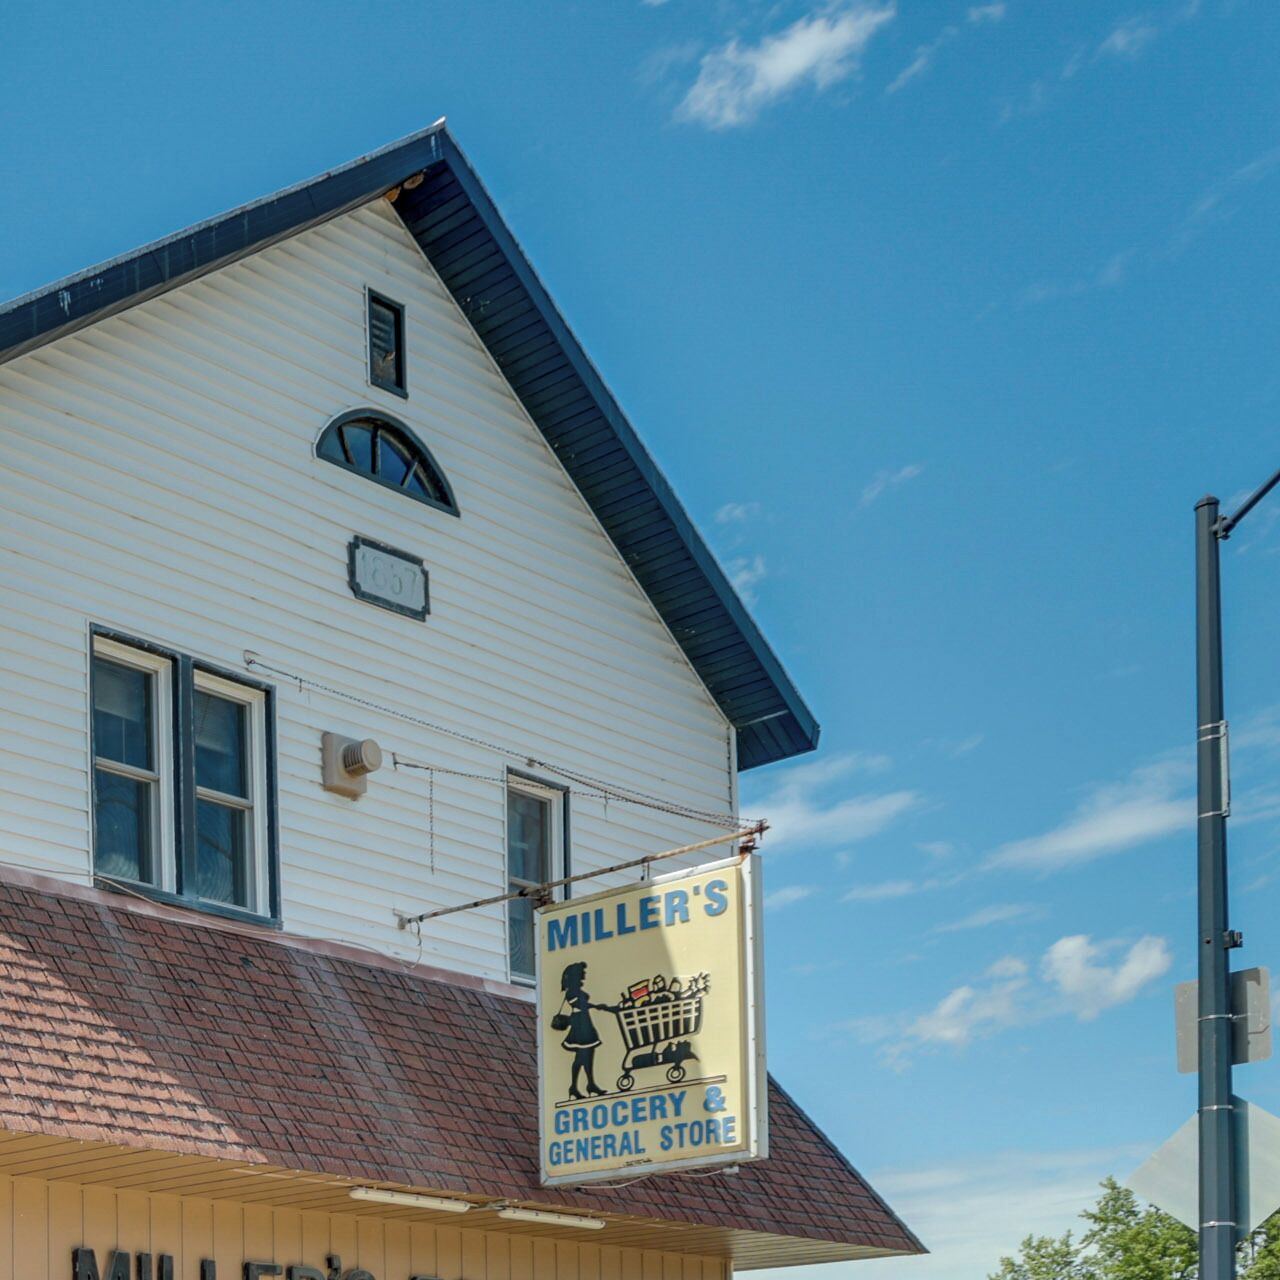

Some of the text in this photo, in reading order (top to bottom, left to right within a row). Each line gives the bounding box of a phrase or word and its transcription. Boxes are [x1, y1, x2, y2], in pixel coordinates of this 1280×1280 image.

[547, 879, 728, 952] MILLER'S
[554, 1085, 727, 1135] GROCERY &
[549, 1116, 737, 1167] GENERAL STORE
